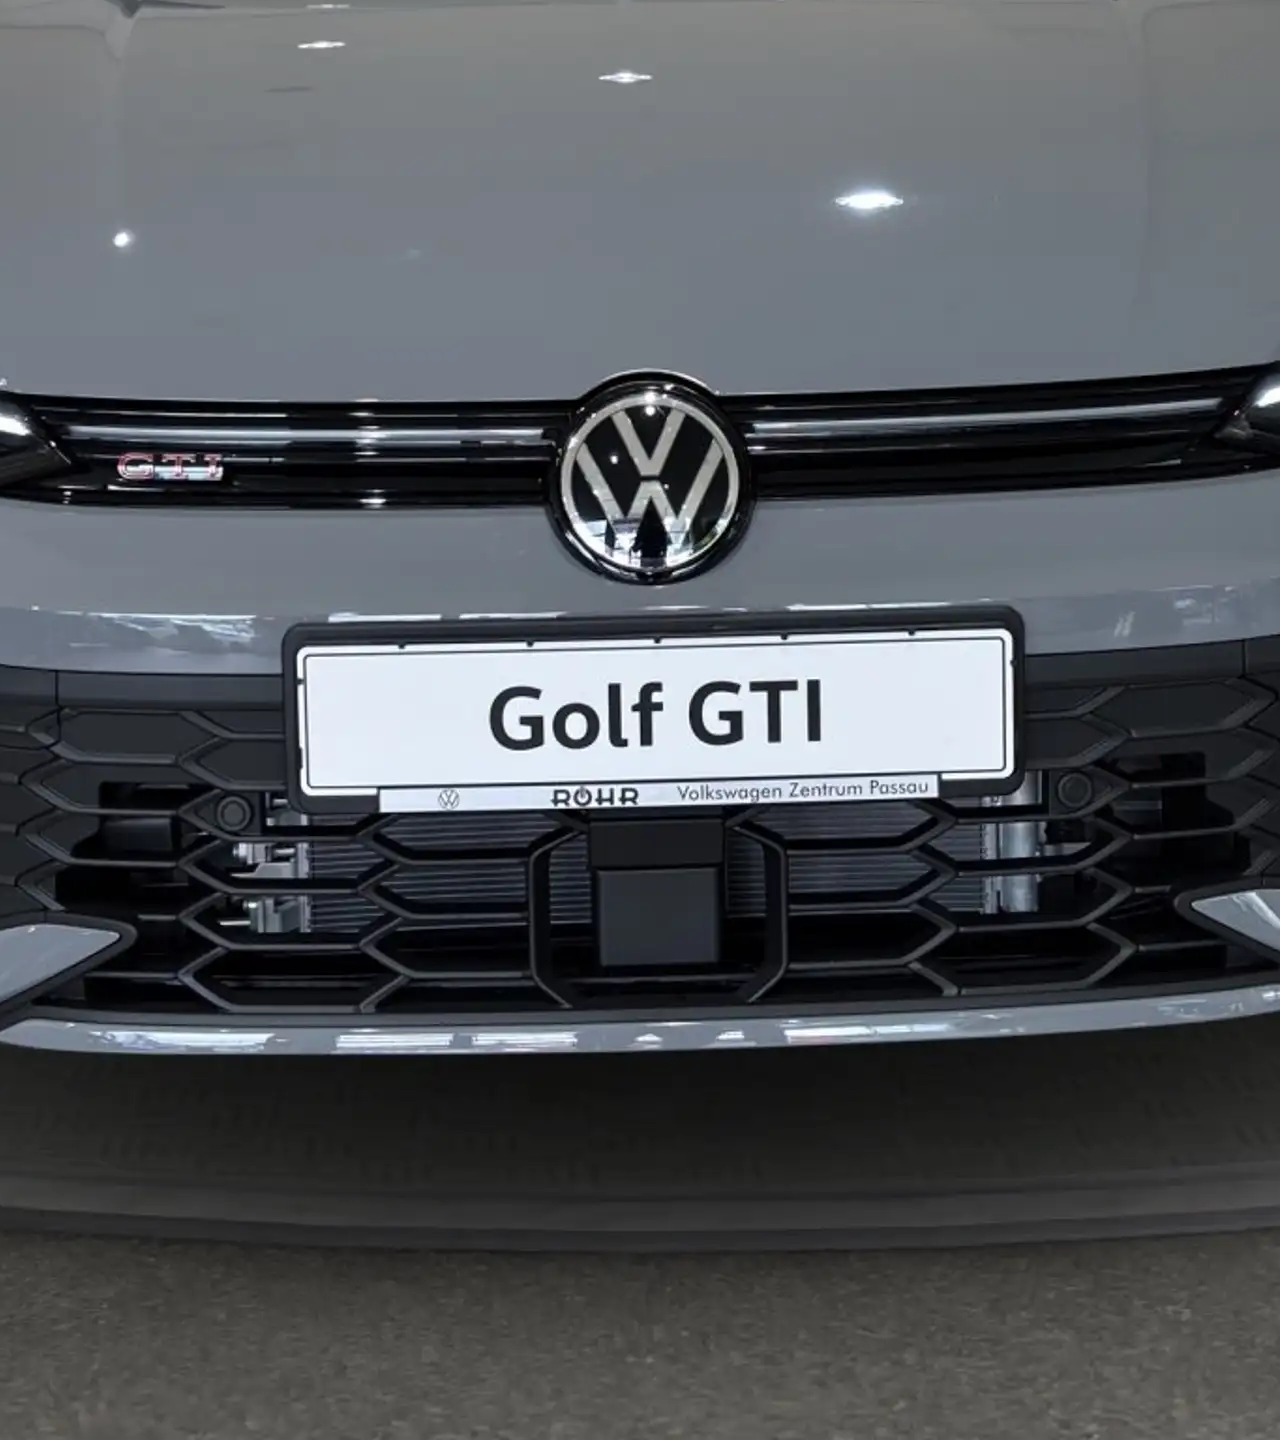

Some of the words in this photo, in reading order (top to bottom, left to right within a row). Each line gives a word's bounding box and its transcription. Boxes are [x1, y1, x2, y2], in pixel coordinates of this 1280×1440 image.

[116, 451, 224, 481] GTI
[489, 681, 664, 751] Golf
[688, 679, 821, 746] GTI
[677, 784, 782, 803] Volkswagen
[789, 782, 863, 799] Zentrum
[869, 779, 929, 796] Passau
